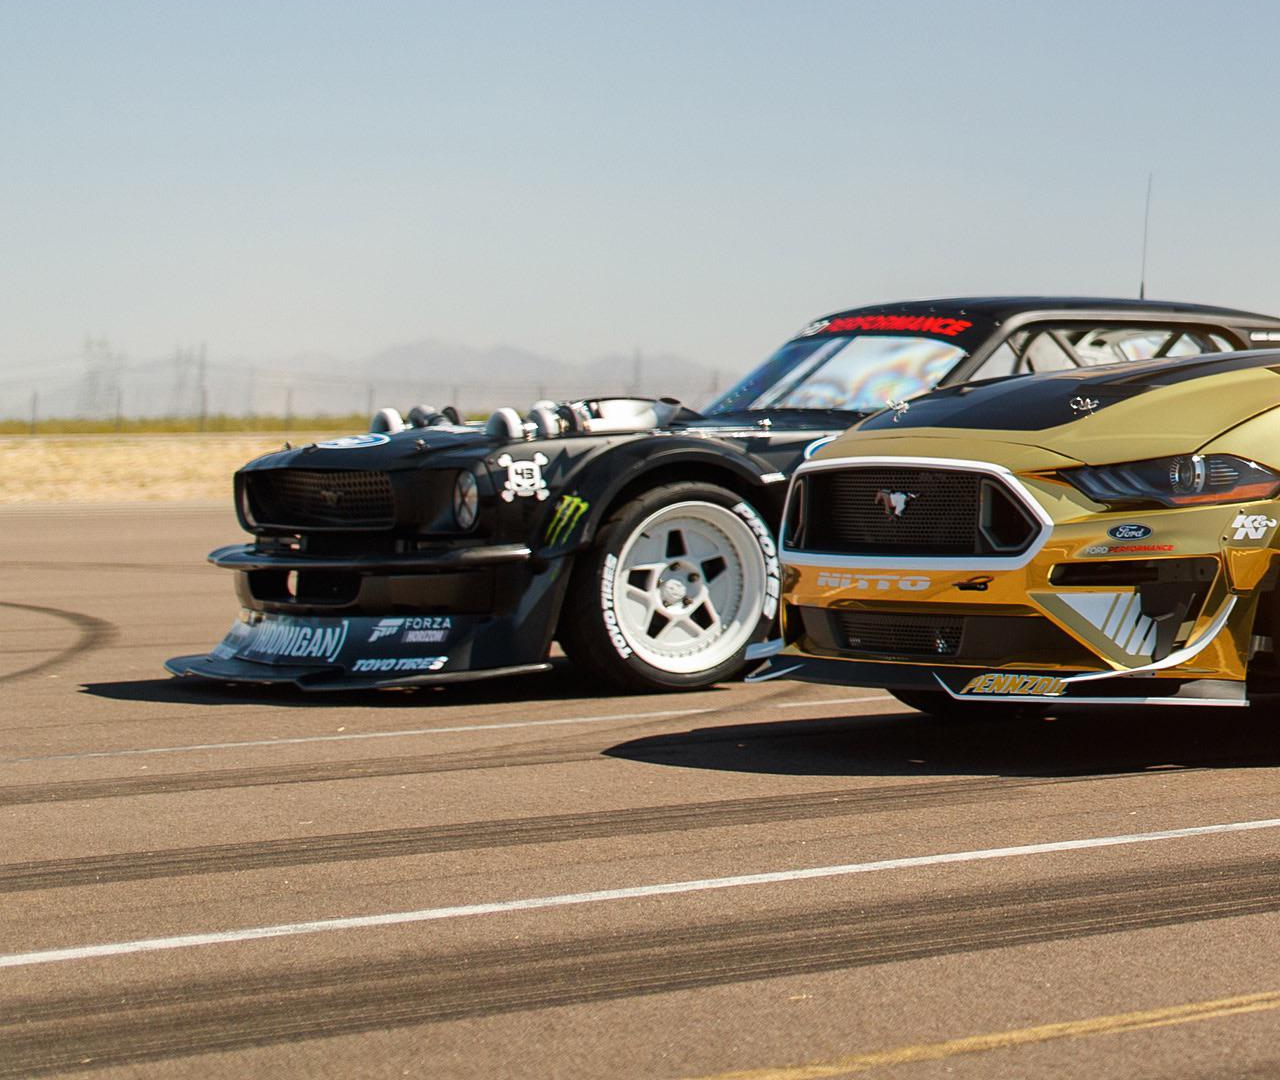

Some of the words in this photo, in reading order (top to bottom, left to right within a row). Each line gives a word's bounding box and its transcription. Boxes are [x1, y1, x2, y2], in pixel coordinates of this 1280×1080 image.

[514, 468, 534, 480] 43
[732, 501, 781, 620] PROXES
[817, 572, 932, 591] NITTO
[404, 617, 452, 630] FORZA
